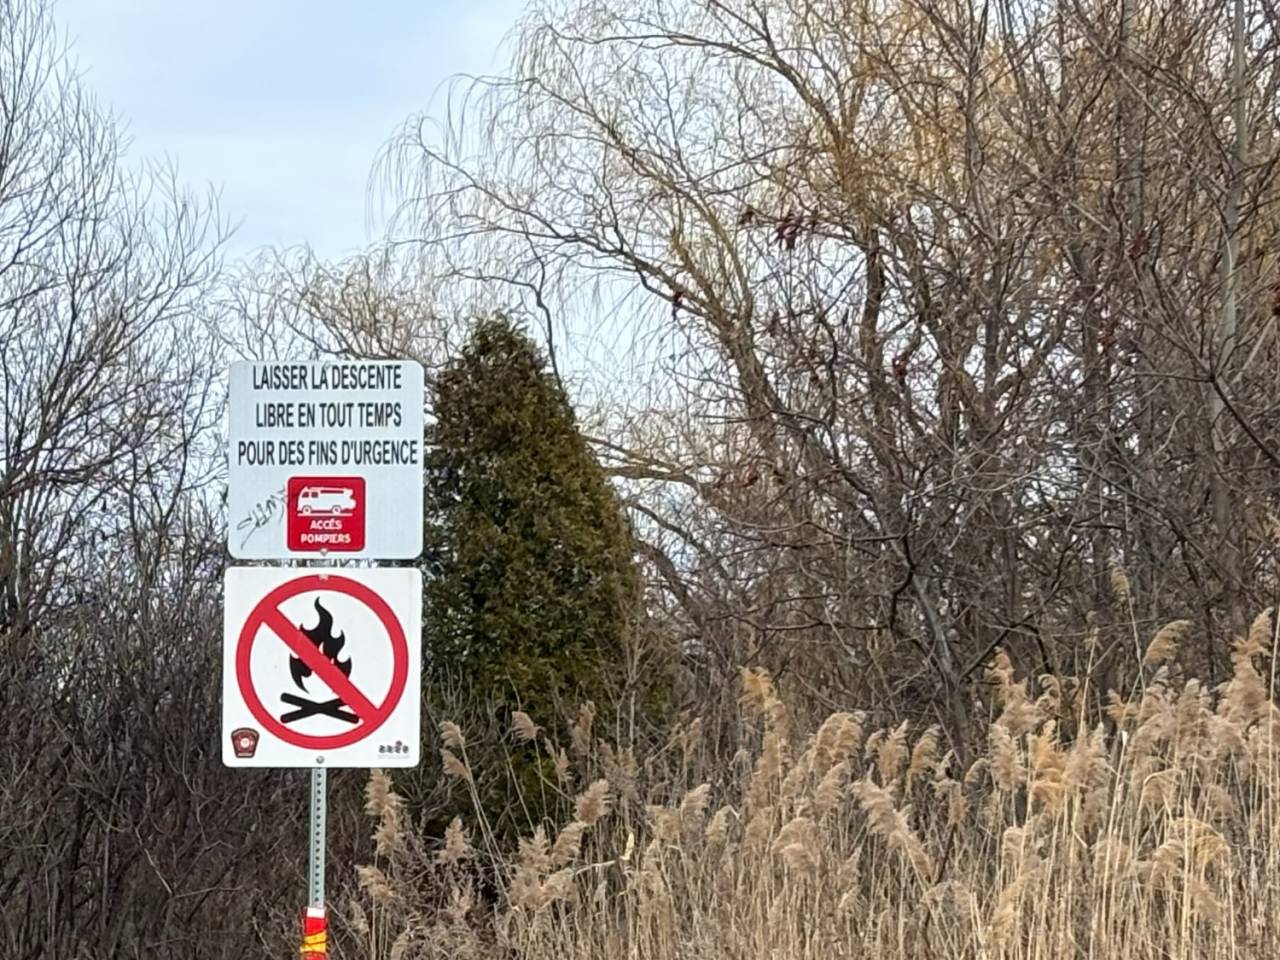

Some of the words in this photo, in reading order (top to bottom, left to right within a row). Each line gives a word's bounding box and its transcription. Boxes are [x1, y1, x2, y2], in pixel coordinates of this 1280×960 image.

[253, 365, 308, 390] LAISSER
[311, 365, 328, 390] LA
[331, 364, 402, 390] DESCENTE
[256, 403, 294, 428] LIBRE
[298, 403, 315, 428] EN
[319, 403, 354, 428] TOUT
[357, 402, 402, 428] TEMPS
[238, 441, 275, 466] POUR
[279, 441, 304, 466] DES
[309, 440, 337, 466] FINS
[341, 440, 418, 466] D'URGENCE
[300, 533, 351, 544] POMPIERS
